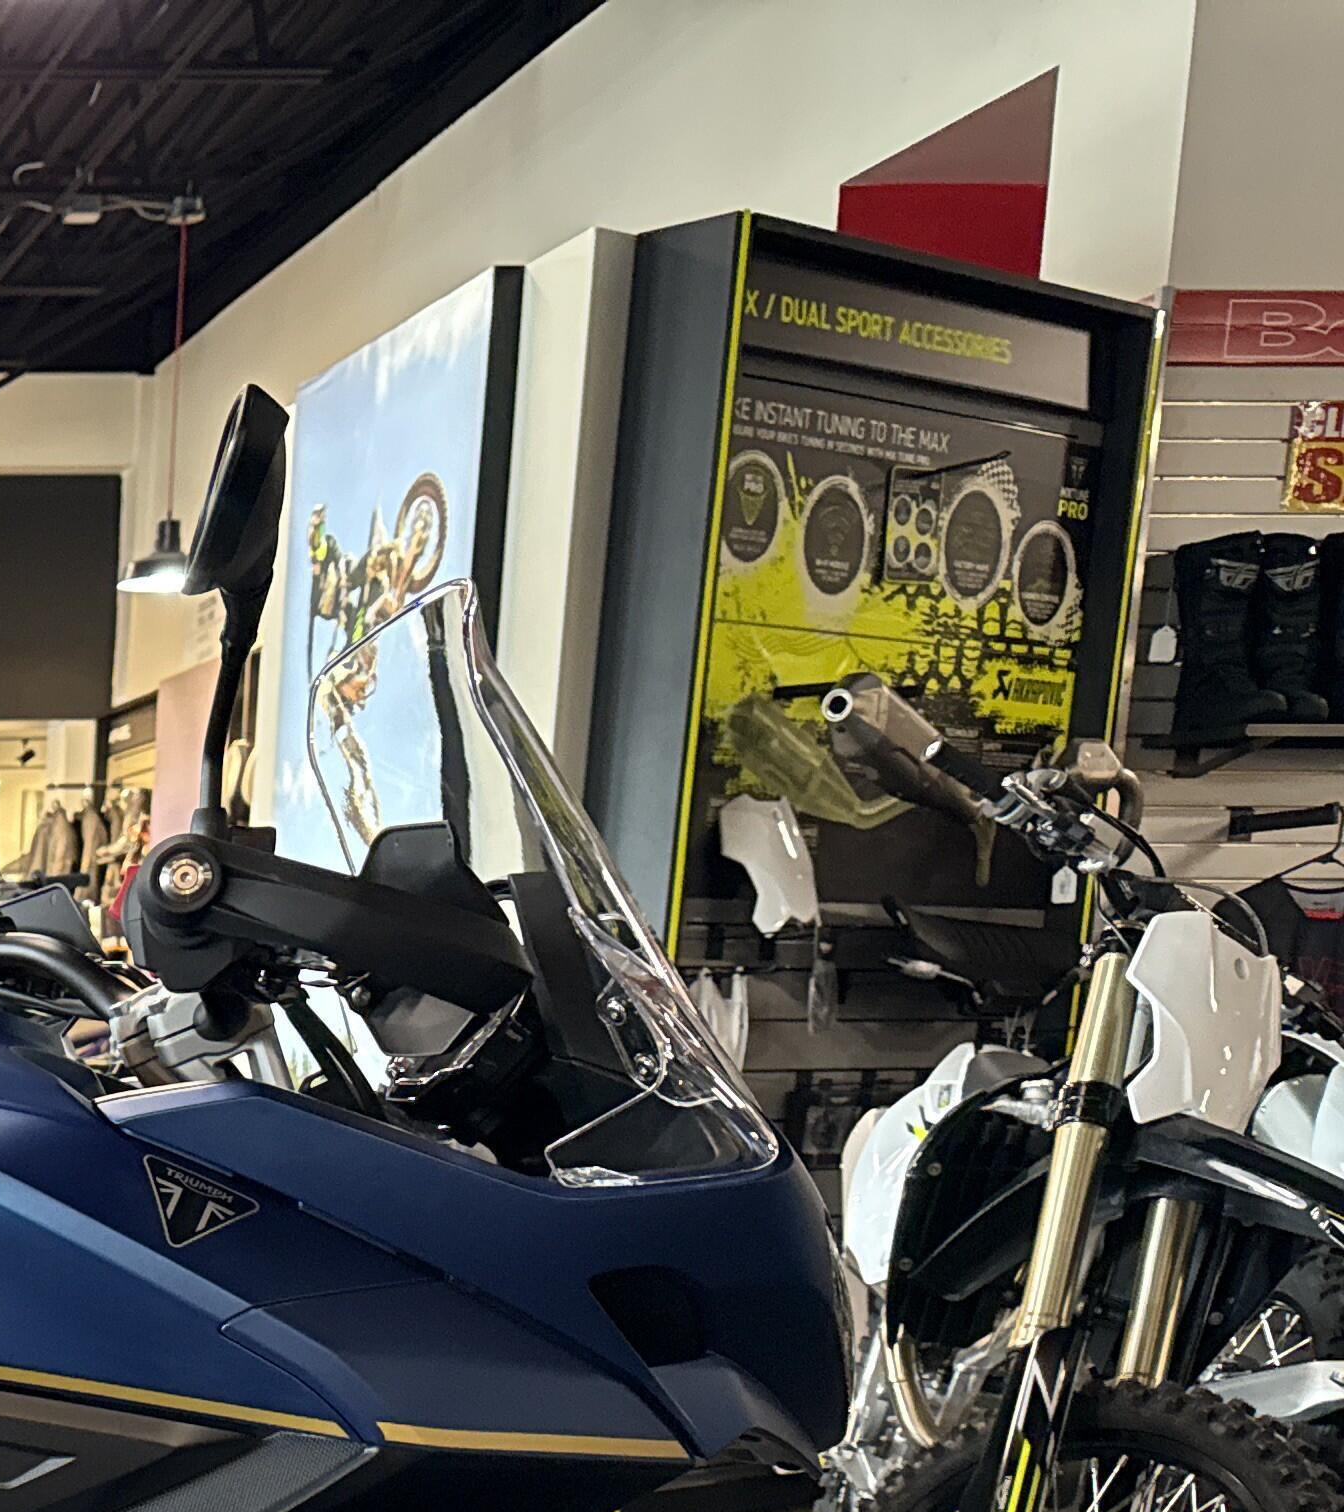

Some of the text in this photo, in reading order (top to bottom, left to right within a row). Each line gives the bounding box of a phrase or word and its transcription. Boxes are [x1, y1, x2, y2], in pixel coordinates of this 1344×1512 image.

[780, 295, 831, 331] DUAL
[835, 306, 894, 342] SPORT
[898, 320, 1013, 364] ACCESSORIES
[754, 401, 813, 430] INSTANT
[816, 410, 866, 440] TUNING
[870, 420, 888, 443] TO
[891, 424, 918, 448] THE
[918, 429, 951, 454] MAX
[1056, 500, 1089, 521] PRO
[165, 1166, 234, 1203] TRIUMPH
